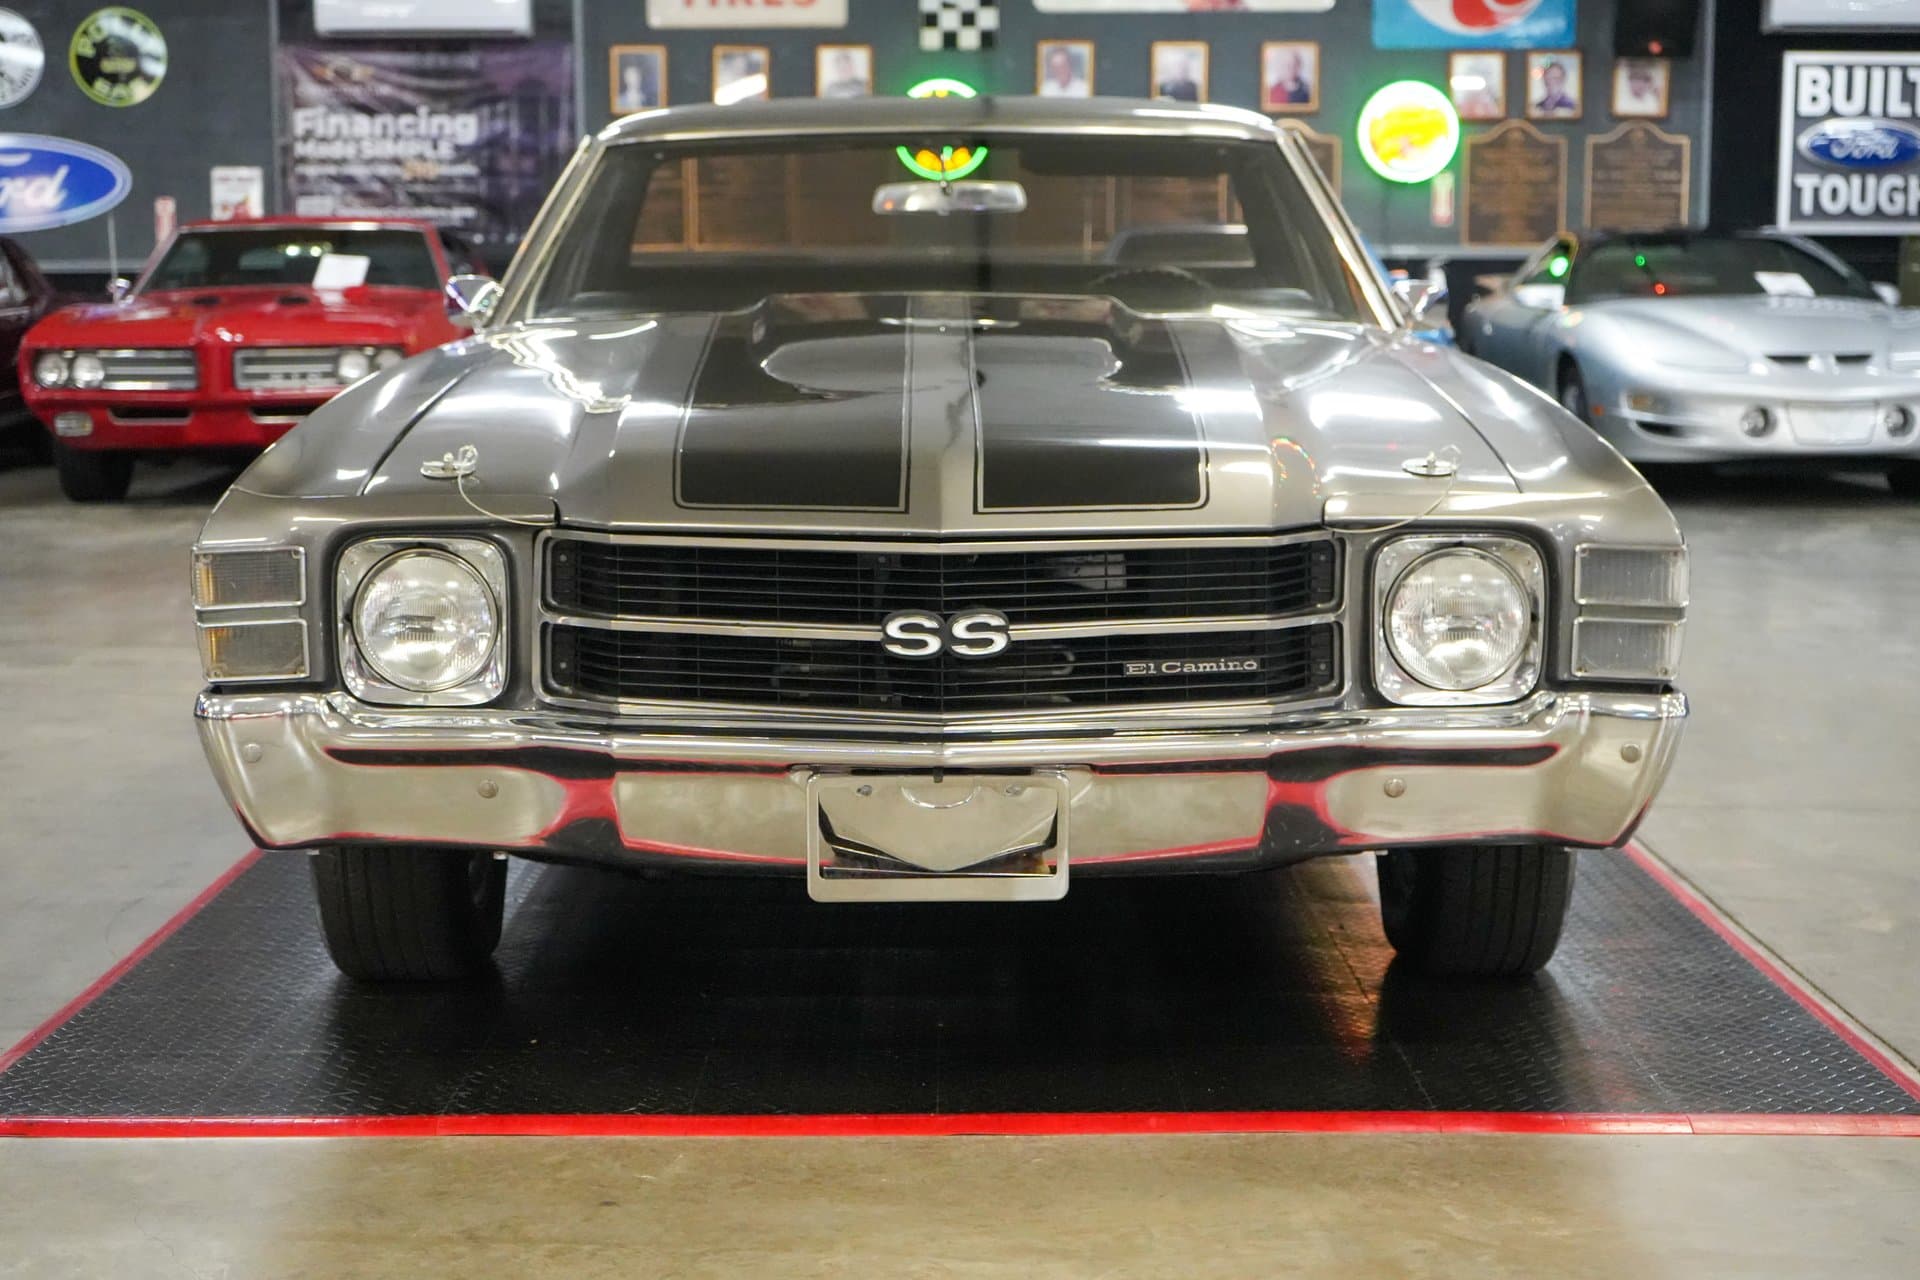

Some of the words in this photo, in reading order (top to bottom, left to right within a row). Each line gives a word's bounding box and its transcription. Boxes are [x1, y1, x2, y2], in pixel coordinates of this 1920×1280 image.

[293, 105, 479, 146] Financing
[883, 611, 1010, 658] SS
[1126, 663, 1157, 675] El
[1161, 658, 1258, 674] Camino
